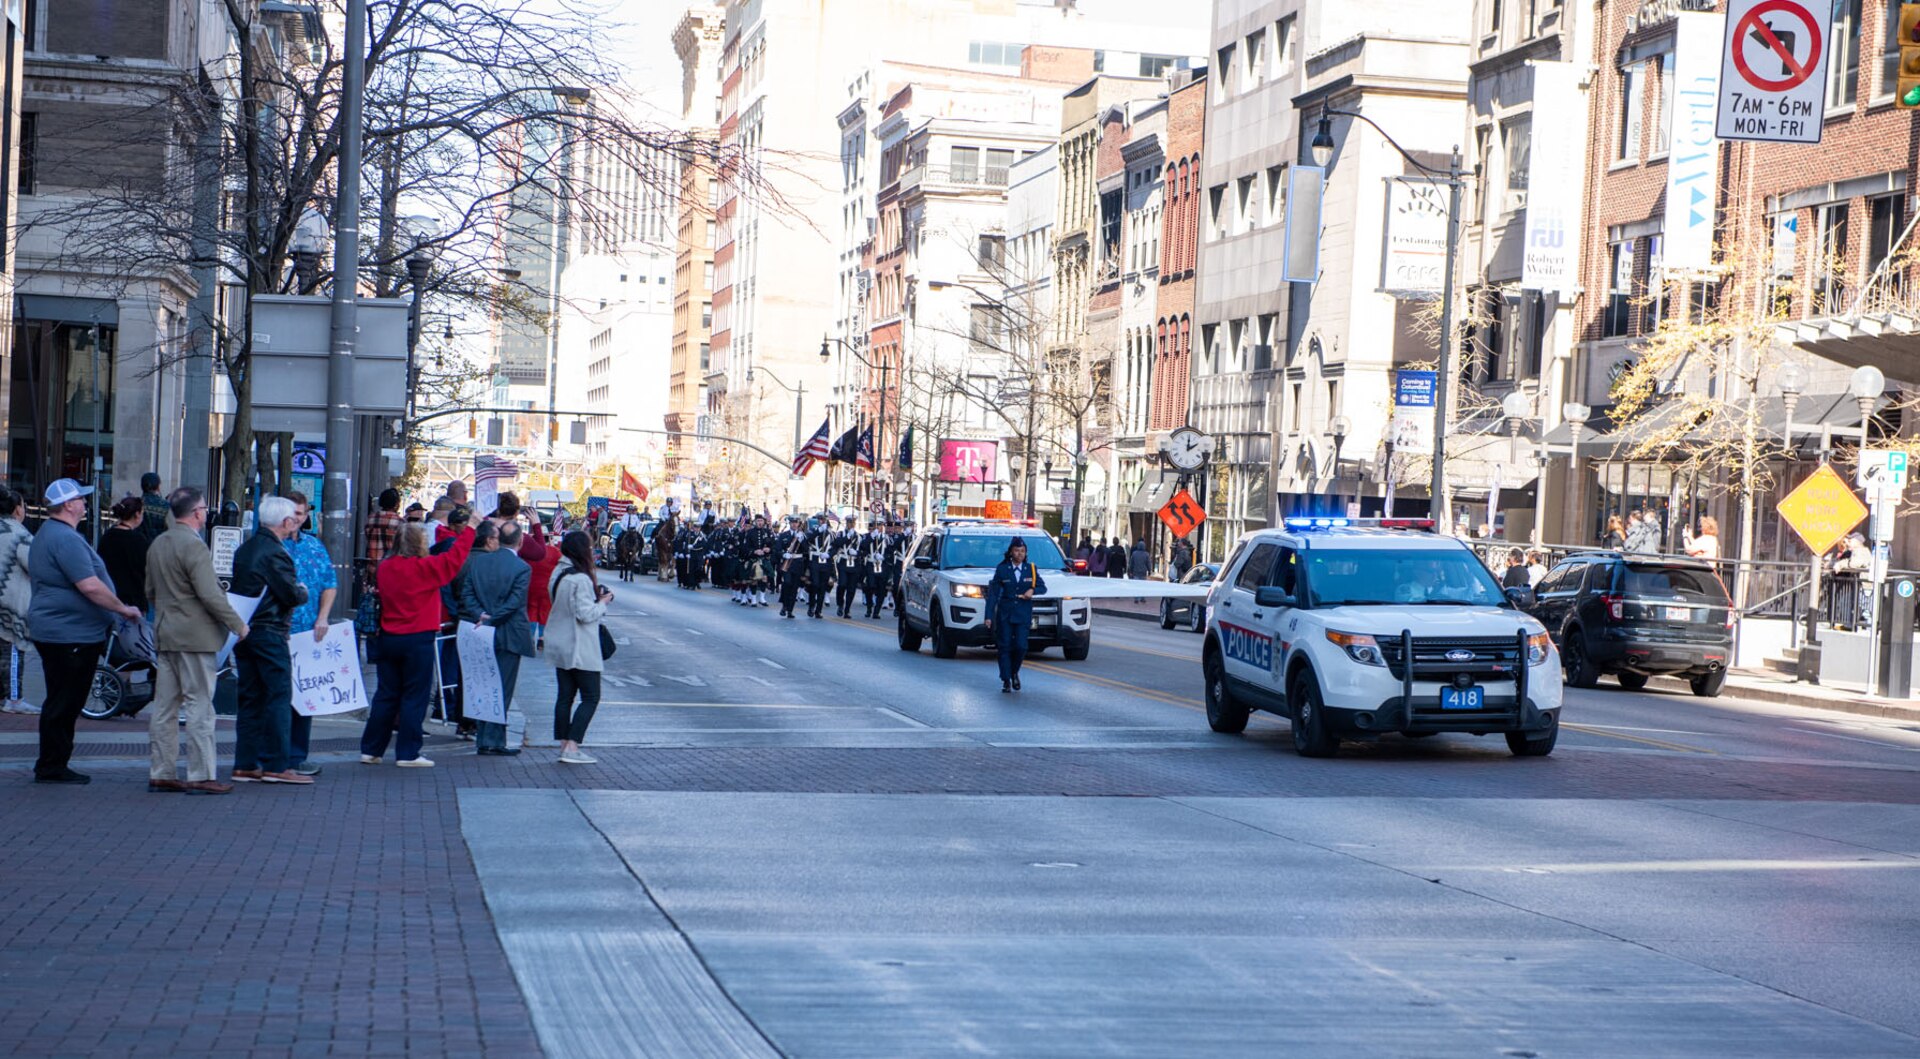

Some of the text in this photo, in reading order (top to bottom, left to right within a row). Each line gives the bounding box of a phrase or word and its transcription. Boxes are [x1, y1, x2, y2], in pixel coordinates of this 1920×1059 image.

[1731, 93, 1763, 114] 7AM
[1778, 95, 1813, 117] 6PM
[1675, 76, 1716, 186] Werth
[1734, 117, 1767, 134] MON
[1780, 120, 1805, 136] FRI
[1527, 253, 1565, 264] Robert
[1527, 264, 1564, 275] Weiler
[1401, 378, 1425, 386] Coming
[955, 446, 980, 477] T
[1227, 627, 1270, 667] POLICE
[1448, 691, 1478, 706] 418
